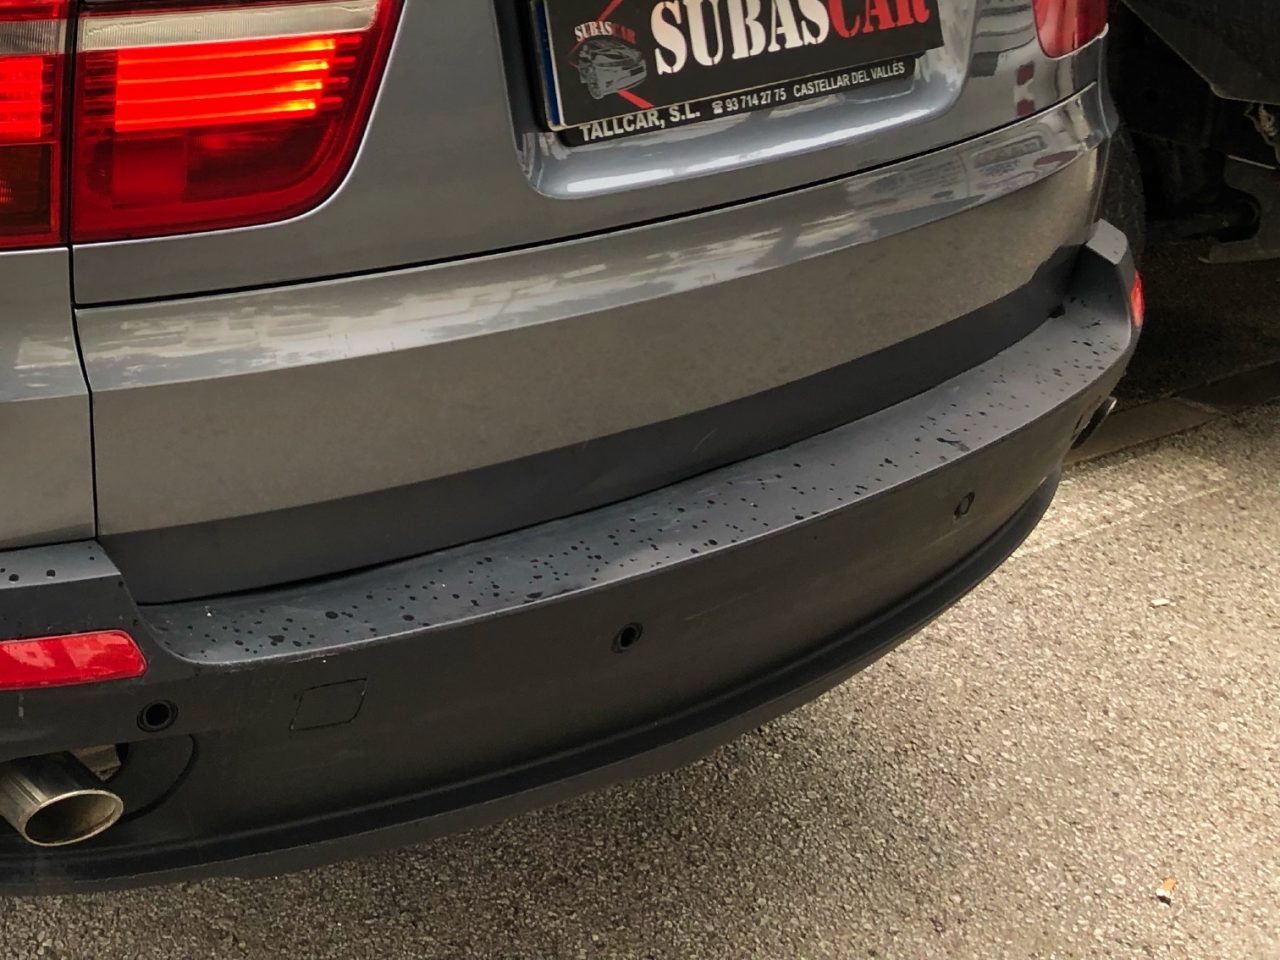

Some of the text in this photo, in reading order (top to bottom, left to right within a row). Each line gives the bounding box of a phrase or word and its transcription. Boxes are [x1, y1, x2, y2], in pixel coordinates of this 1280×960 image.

[725, 97, 739, 111] 93
[740, 93, 759, 108] 714
[760, 90, 772, 104] 27
[773, 87, 787, 101] 75
[793, 73, 850, 97] CASTELLAR
[851, 70, 870, 84] DEL
[579, 102, 701, 141] TALLCAR, S.L.
